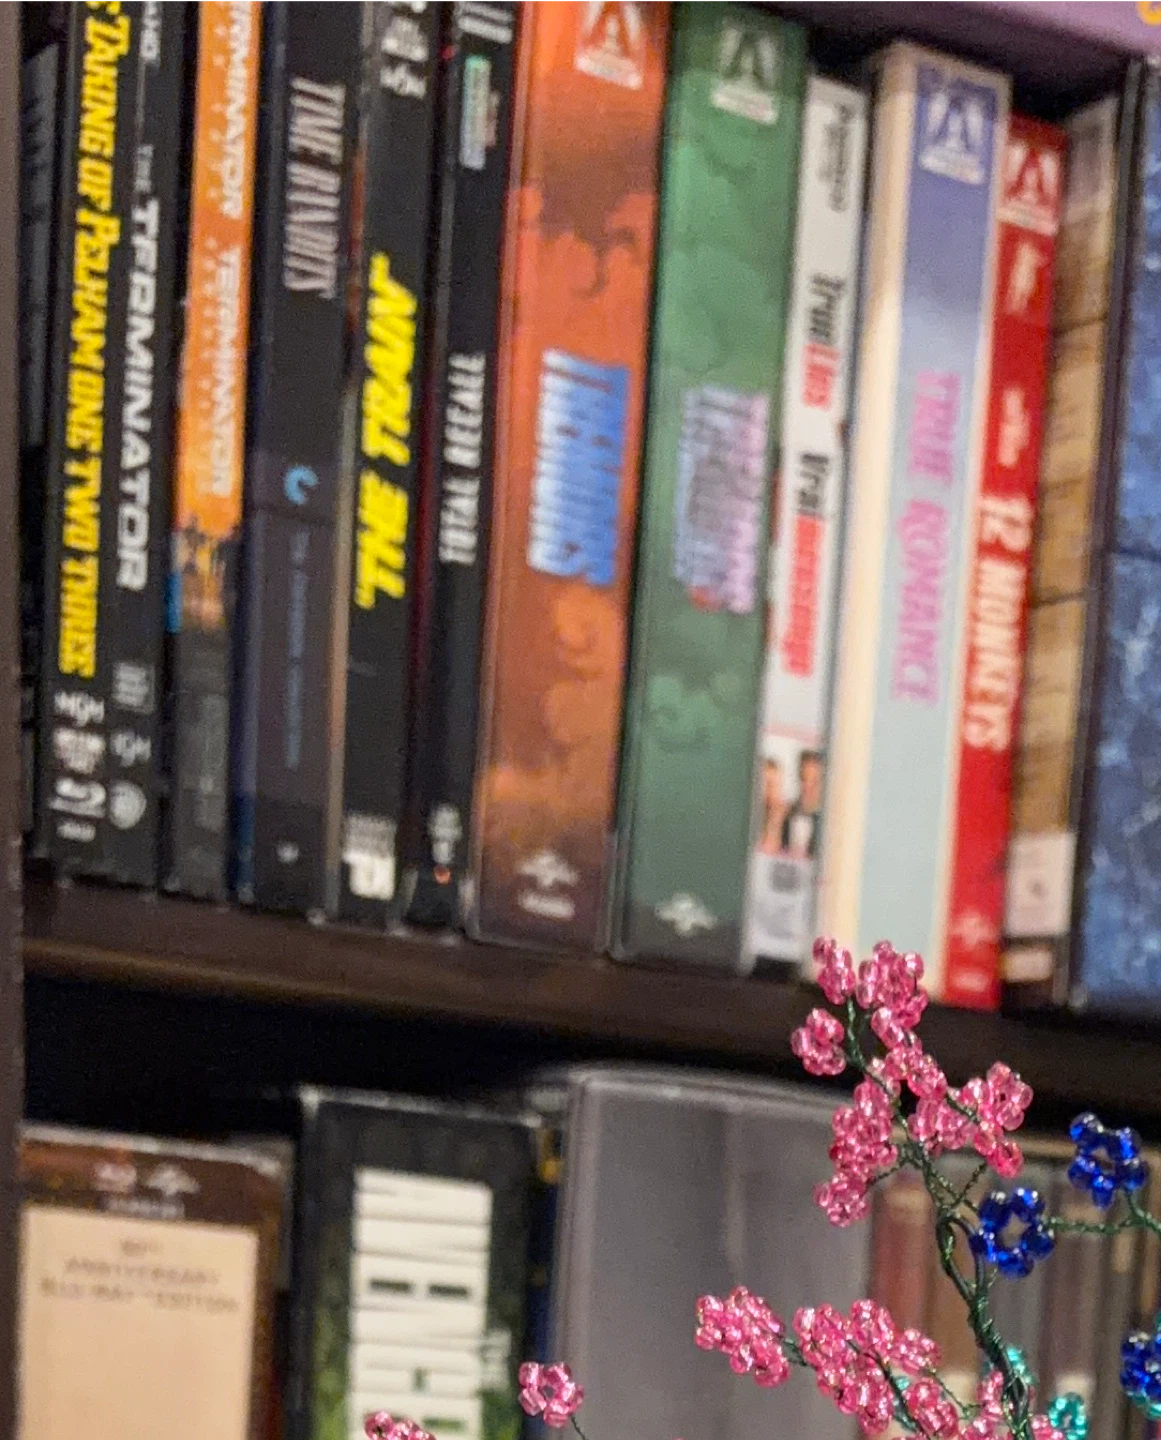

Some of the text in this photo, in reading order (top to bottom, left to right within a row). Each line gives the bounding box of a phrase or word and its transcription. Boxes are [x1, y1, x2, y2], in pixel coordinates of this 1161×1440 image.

[79, 16, 131, 157] TAKING
[77, 159, 113, 210] OF
[283, 76, 346, 300] TIME BANDITS
[69, 208, 121, 371] PELHAM
[65, 374, 105, 450] ONE
[117, 199, 160, 591] TERMINATOR
[439, 352, 487, 565] TOTAL RECALL
[527, 347, 629, 586] TREMORS
[63, 457, 101, 550] TWO
[891, 369, 961, 710] TRUE ROMANCE
[976, 494, 1034, 553] 12
[58, 555, 98, 678] THREE
[963, 557, 1029, 751] MONKEYS
